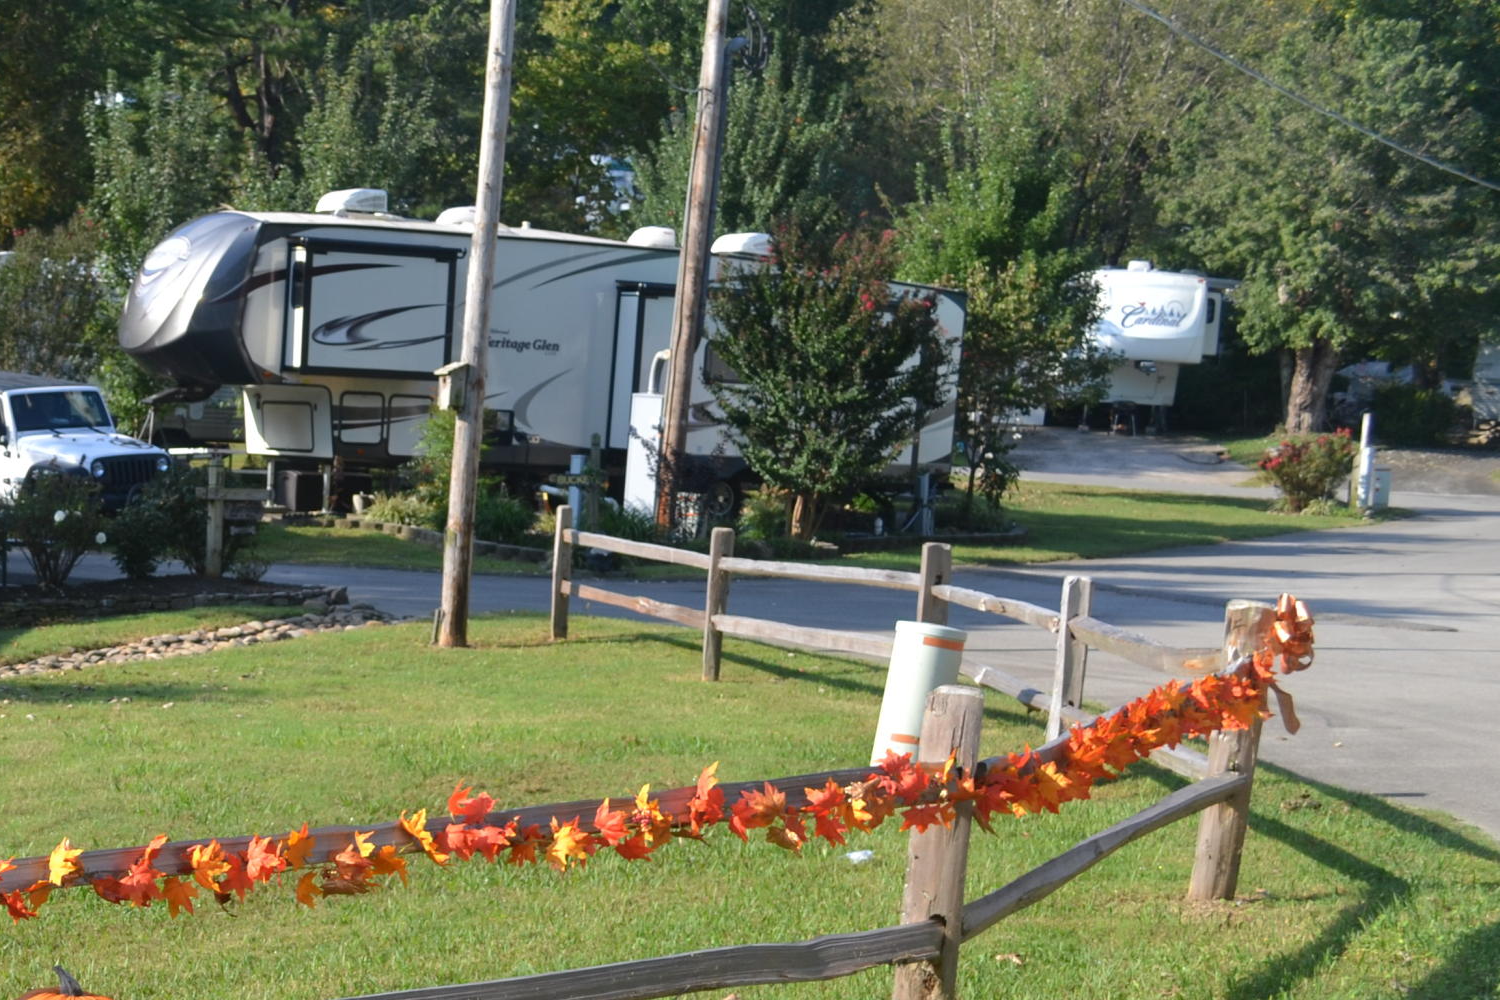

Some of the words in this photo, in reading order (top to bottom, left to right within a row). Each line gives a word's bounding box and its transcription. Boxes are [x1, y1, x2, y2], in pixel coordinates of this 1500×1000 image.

[1121, 304, 1187, 329] Cardinal
[487, 336, 532, 353] eritage
[532, 338, 560, 352] Glen
